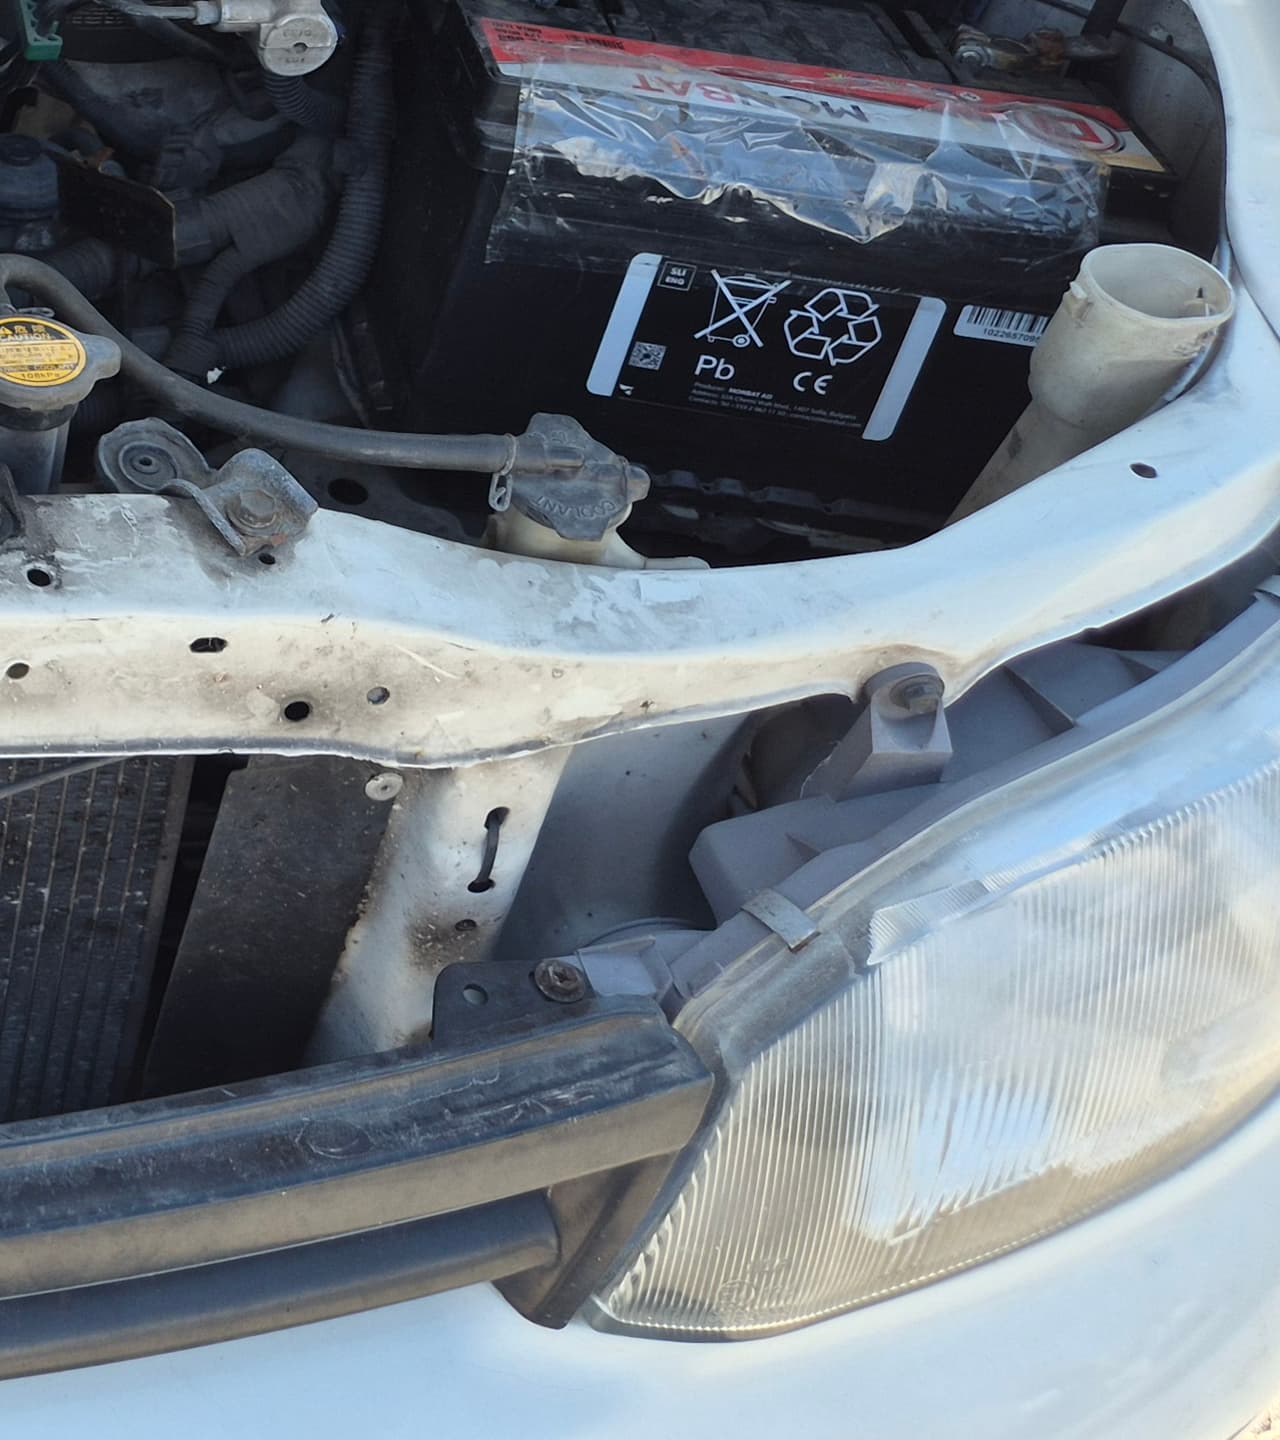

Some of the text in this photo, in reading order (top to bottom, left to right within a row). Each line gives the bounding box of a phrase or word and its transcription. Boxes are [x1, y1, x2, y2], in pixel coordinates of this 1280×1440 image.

[631, 73, 870, 123] MOBAT
[693, 353, 736, 381] Pb
[792, 371, 834, 396] CE
[530, 495, 617, 521] COOLANT
